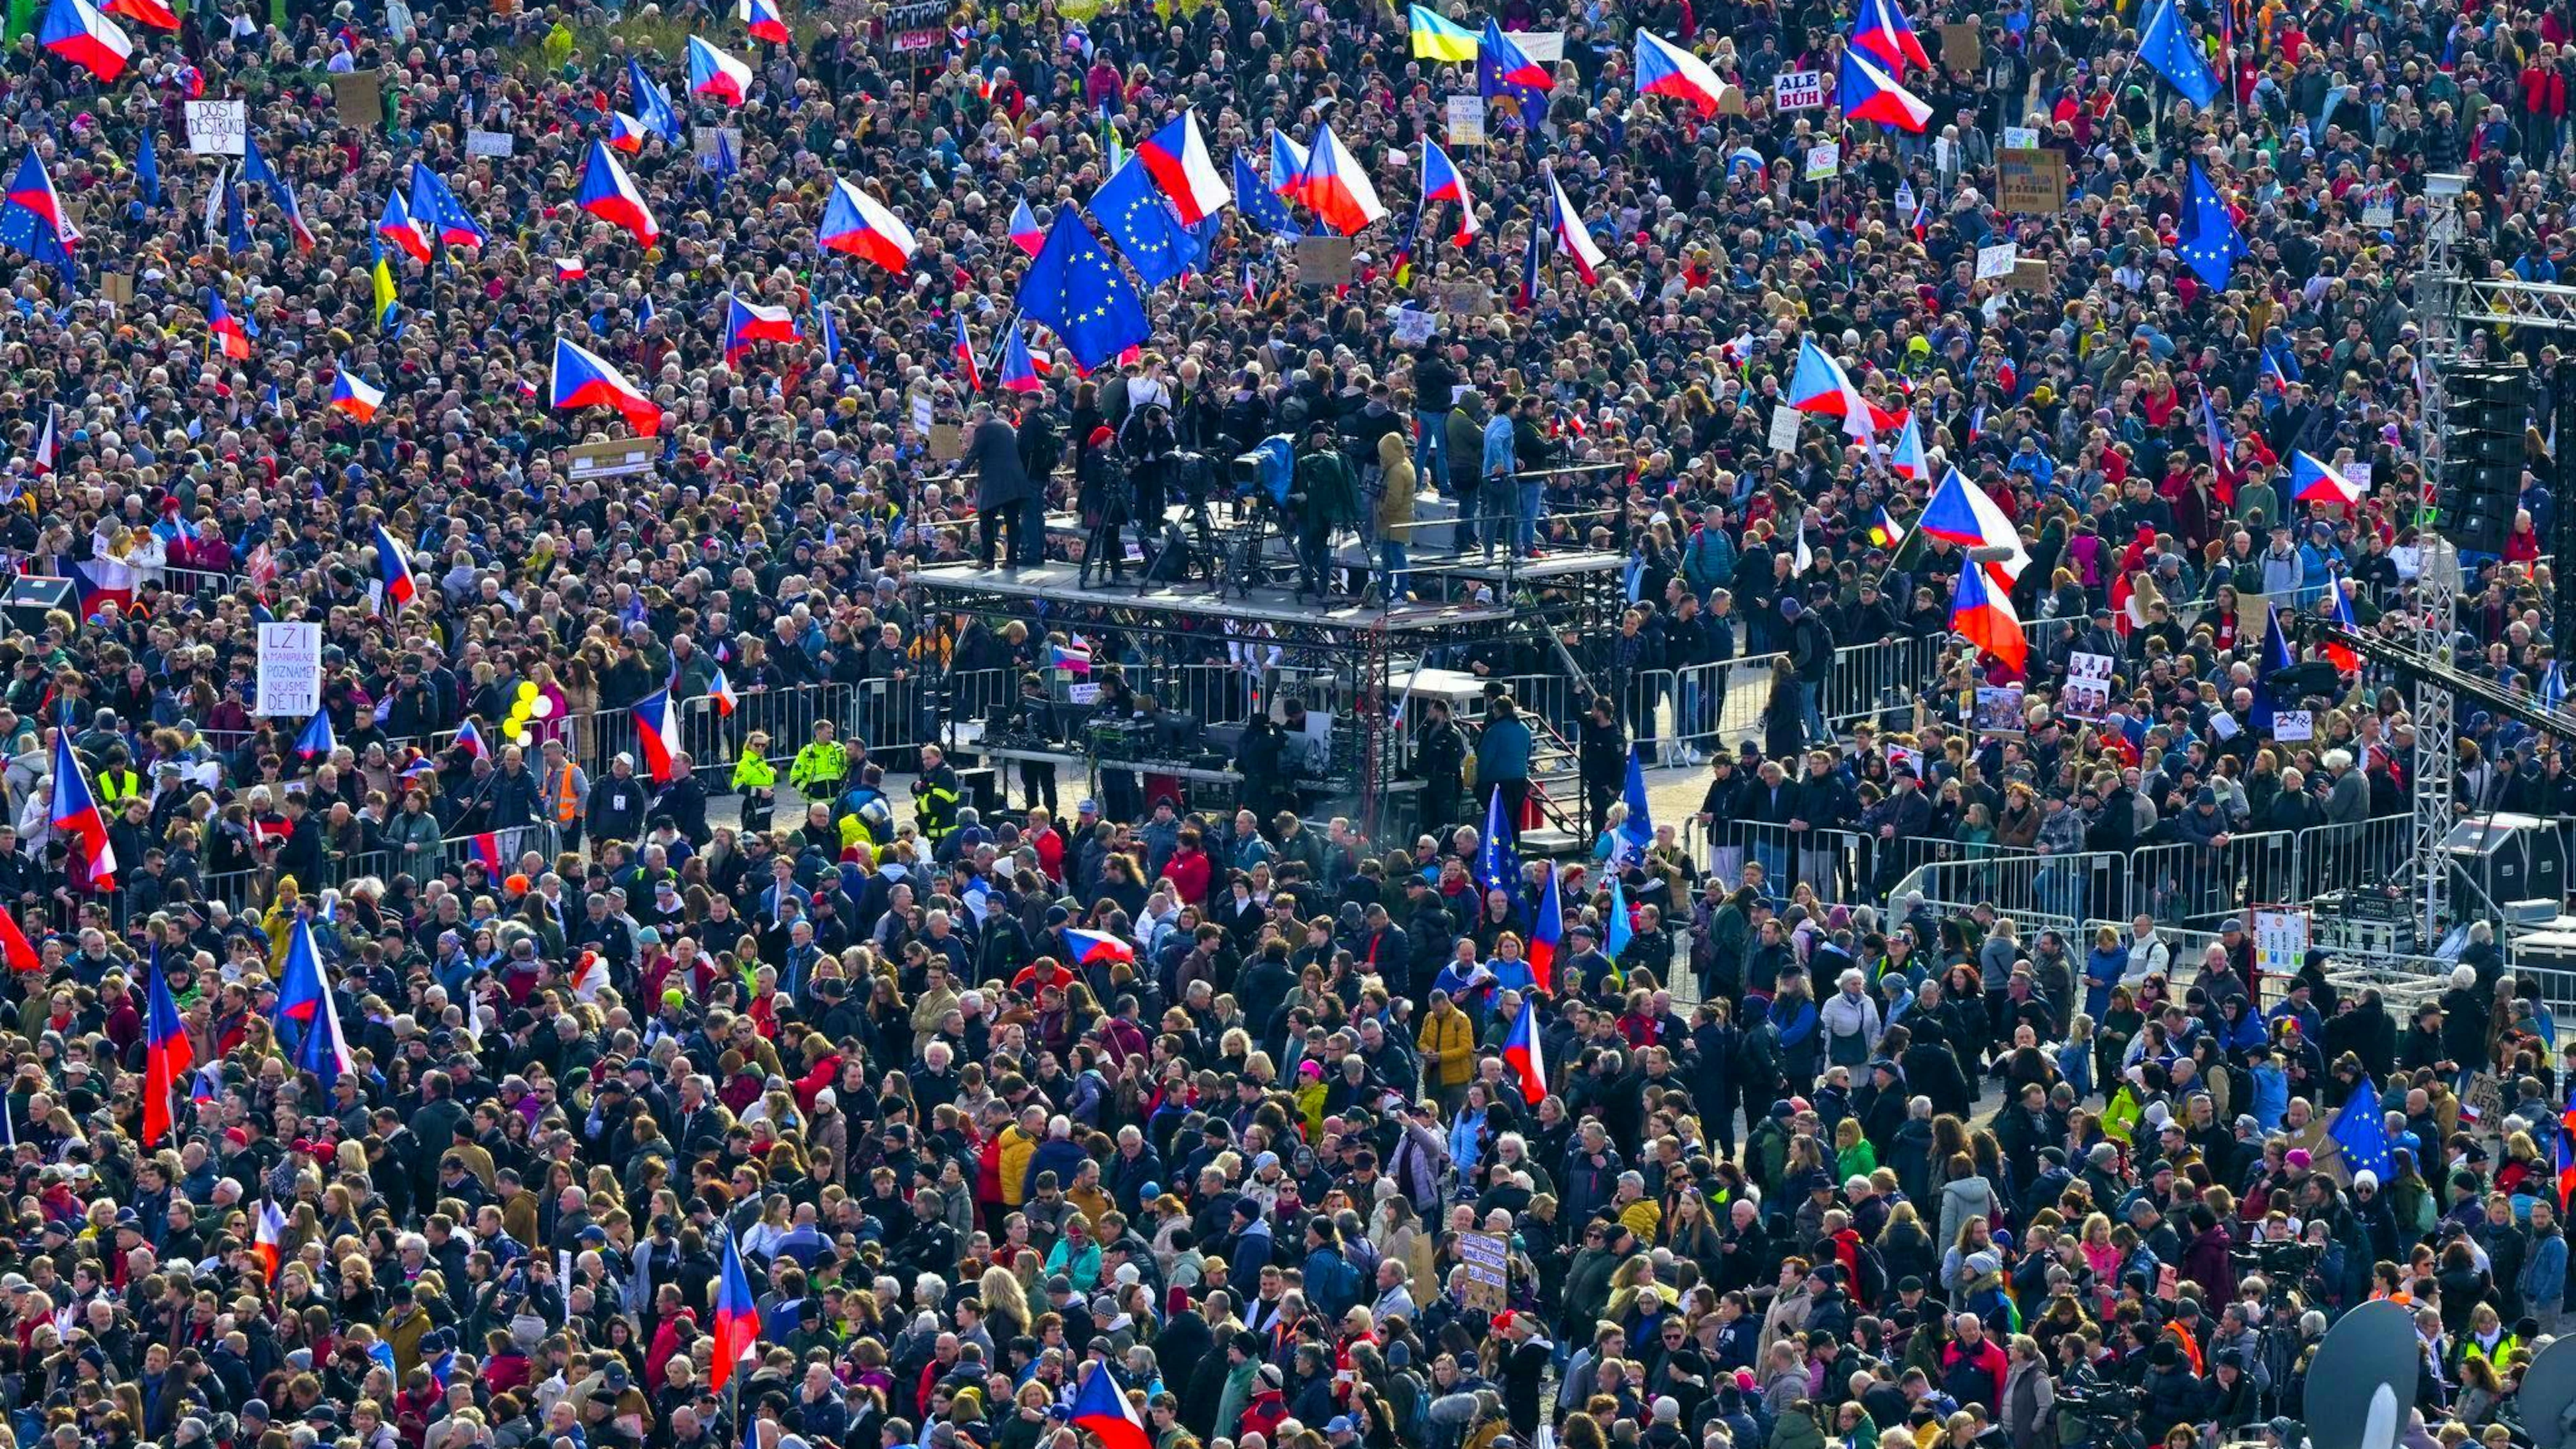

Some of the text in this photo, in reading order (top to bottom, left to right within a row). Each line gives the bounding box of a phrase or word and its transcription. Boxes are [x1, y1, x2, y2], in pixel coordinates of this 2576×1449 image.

[1778, 74, 1817, 91] ALE
[262, 652, 268, 661] A
[270, 681, 308, 692] NEJSME
